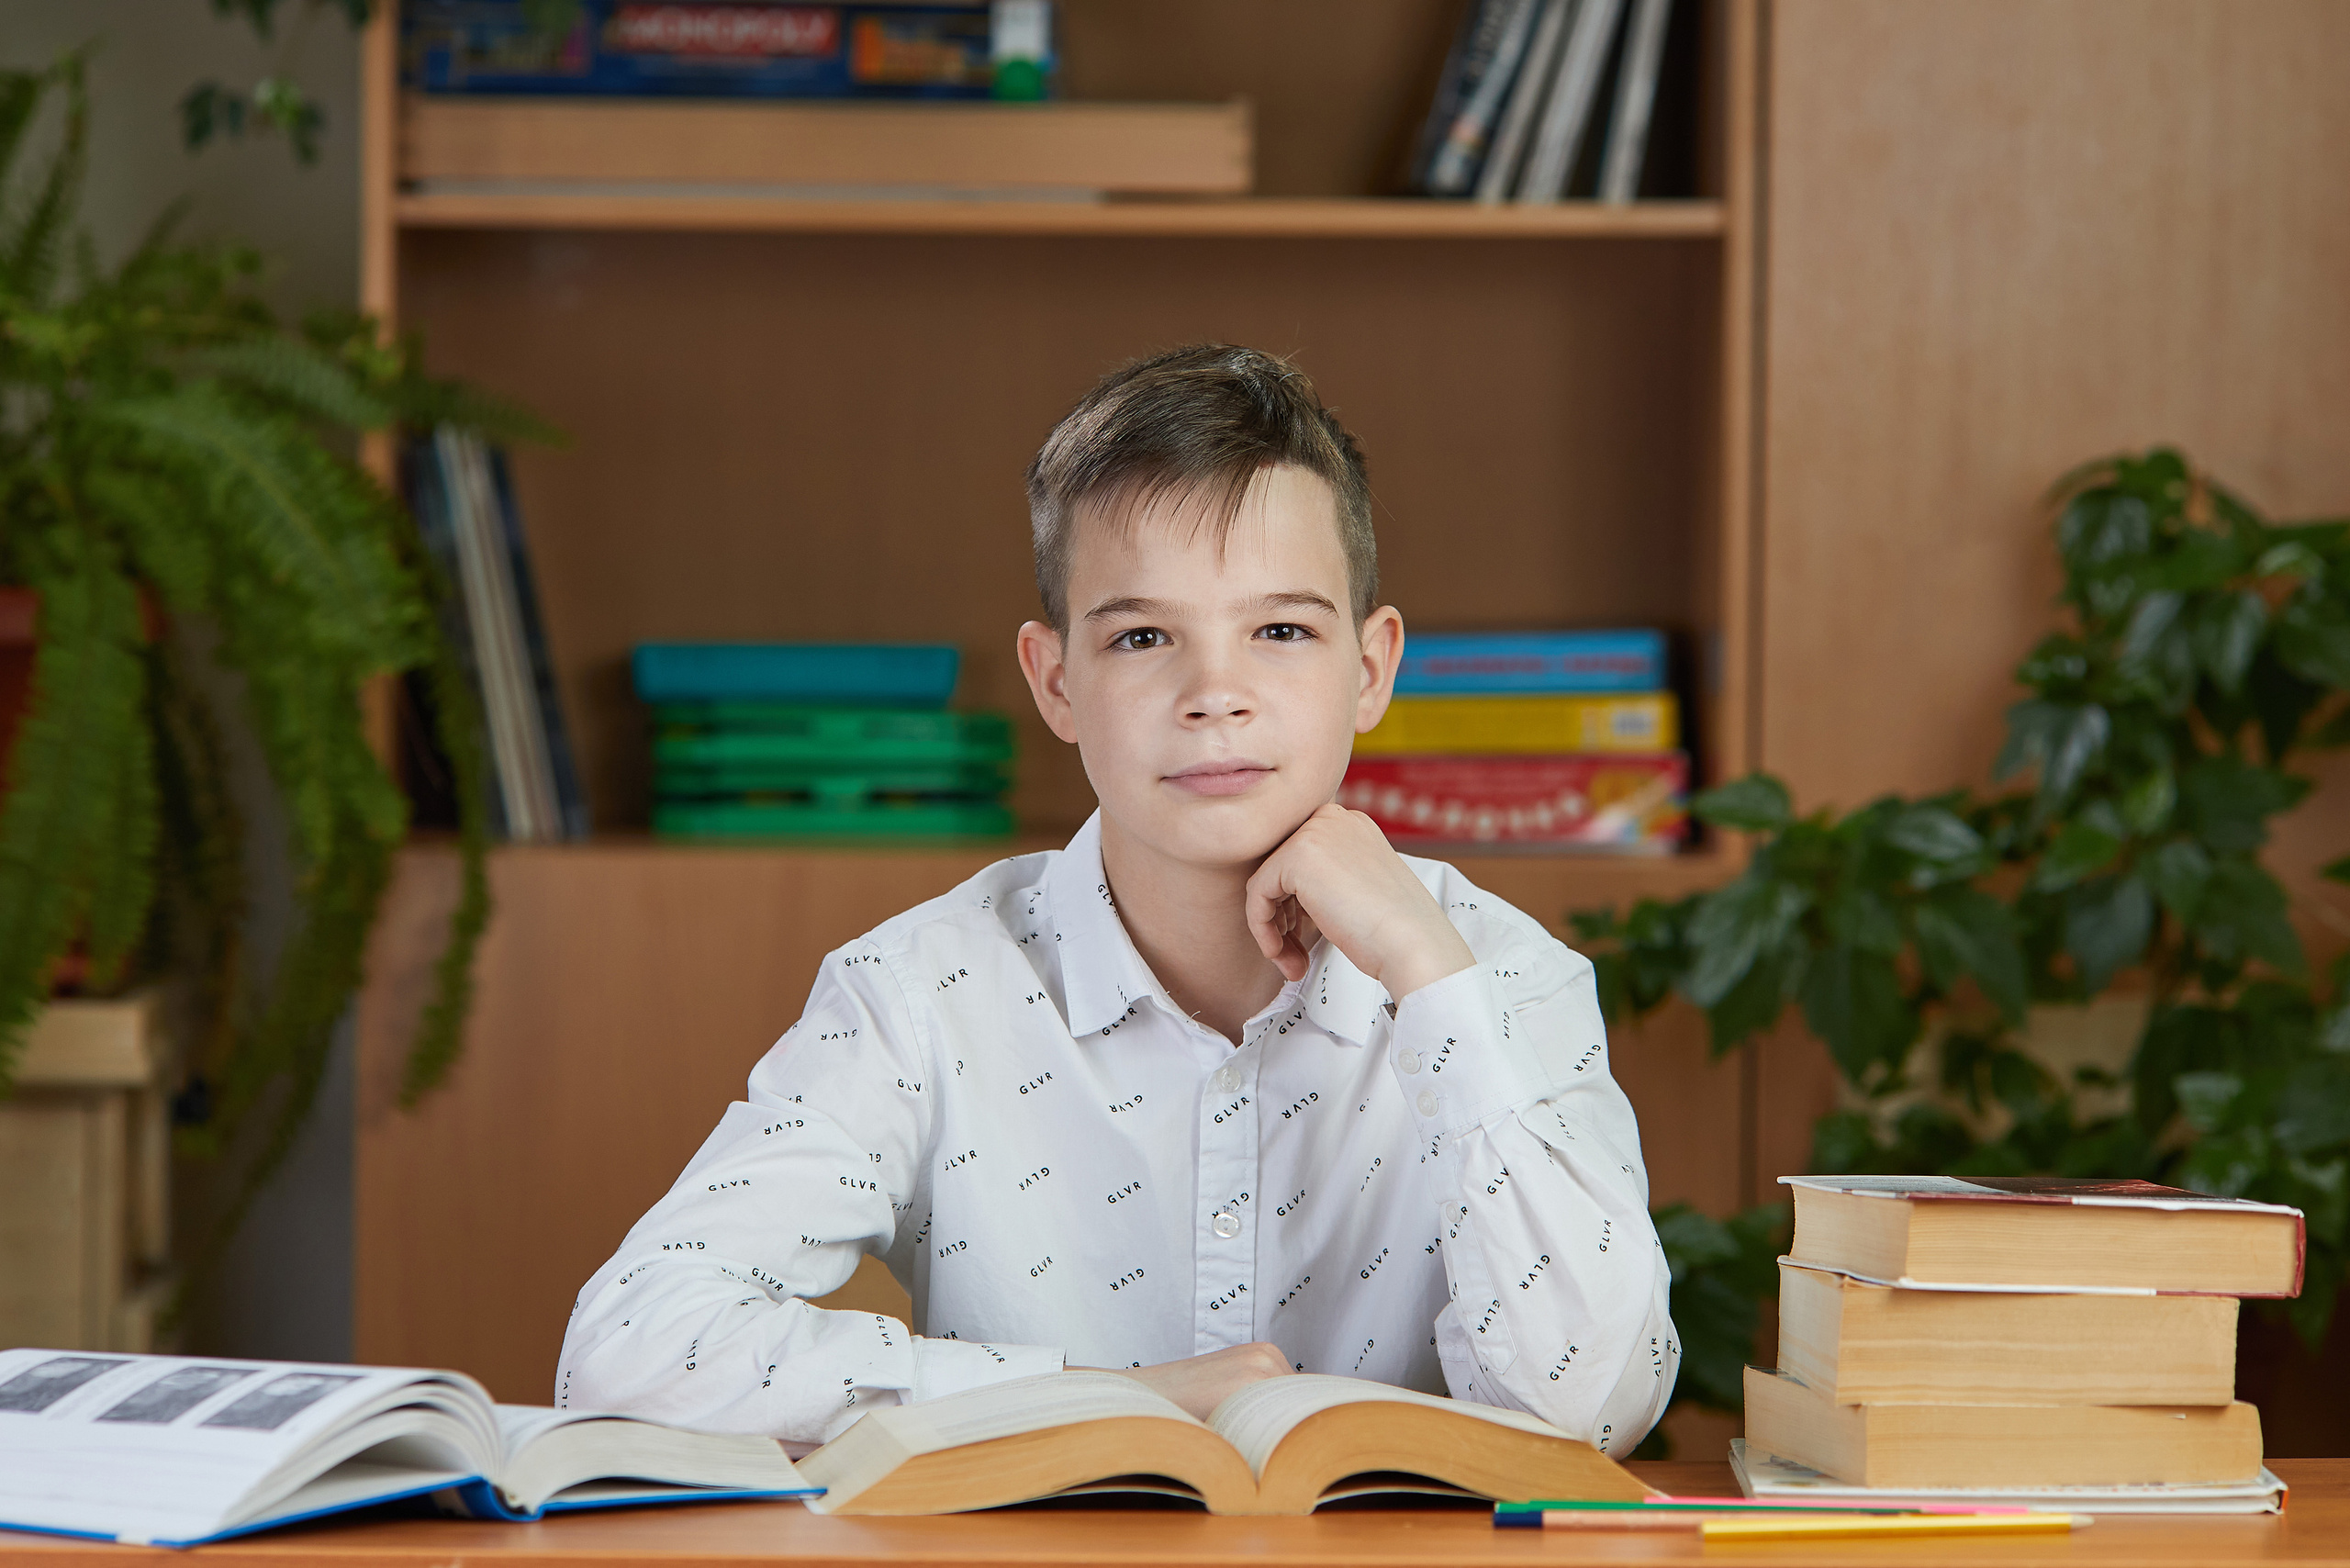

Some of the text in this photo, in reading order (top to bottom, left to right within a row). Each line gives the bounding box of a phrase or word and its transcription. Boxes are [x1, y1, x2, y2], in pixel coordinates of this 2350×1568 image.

[1098, 884, 1118, 918] GLV
[845, 955, 881, 967] GLVR
[936, 968, 969, 992] LVR
[1025, 991, 1046, 1005] VR
[1102, 1006, 1138, 1036] GLVR
[1278, 1006, 1307, 1036] GLV
[820, 1028, 858, 1041] GLVR
[1432, 1036, 1457, 1073] GLVR
[1572, 1044, 1602, 1072] GLVR
[897, 1078, 928, 1092] GLV
[1019, 1071, 1054, 1095] GLVR
[1108, 1094, 1144, 1114] GLVR
[1214, 1095, 1250, 1124] GLVR
[1281, 1092, 1319, 1119] GLVR
[763, 1119, 804, 1136] GLVR
[868, 1152, 882, 1163] GL
[1429, 1132, 1445, 1158] LVR
[708, 1179, 752, 1192] GLVR
[839, 1176, 877, 1193] GLVR
[1018, 1167, 1050, 1192] GLVR
[1486, 1167, 1511, 1195] GLV
[1107, 1181, 1142, 1204] GLVR
[1276, 1189, 1306, 1217] GLVR
[915, 1212, 932, 1244] GLV
[1598, 1219, 1612, 1253] GLVR
[662, 1241, 706, 1251] GLVR
[938, 1240, 968, 1259] GLVR
[1425, 1238, 1442, 1256] VR
[1030, 1256, 1054, 1278] GLVR
[1360, 1248, 1389, 1280] GLVR
[1518, 1254, 1550, 1290] GLVR
[751, 1267, 785, 1292] GLVR
[1109, 1268, 1145, 1292] GLVR
[1278, 1275, 1311, 1307] GLVR
[1210, 1283, 1248, 1311] GLVR
[875, 1316, 893, 1347] GLVR
[940, 1330, 958, 1341] VR
[1549, 1345, 1580, 1382] GLVR
[1599, 1425, 1612, 1454] GLV
